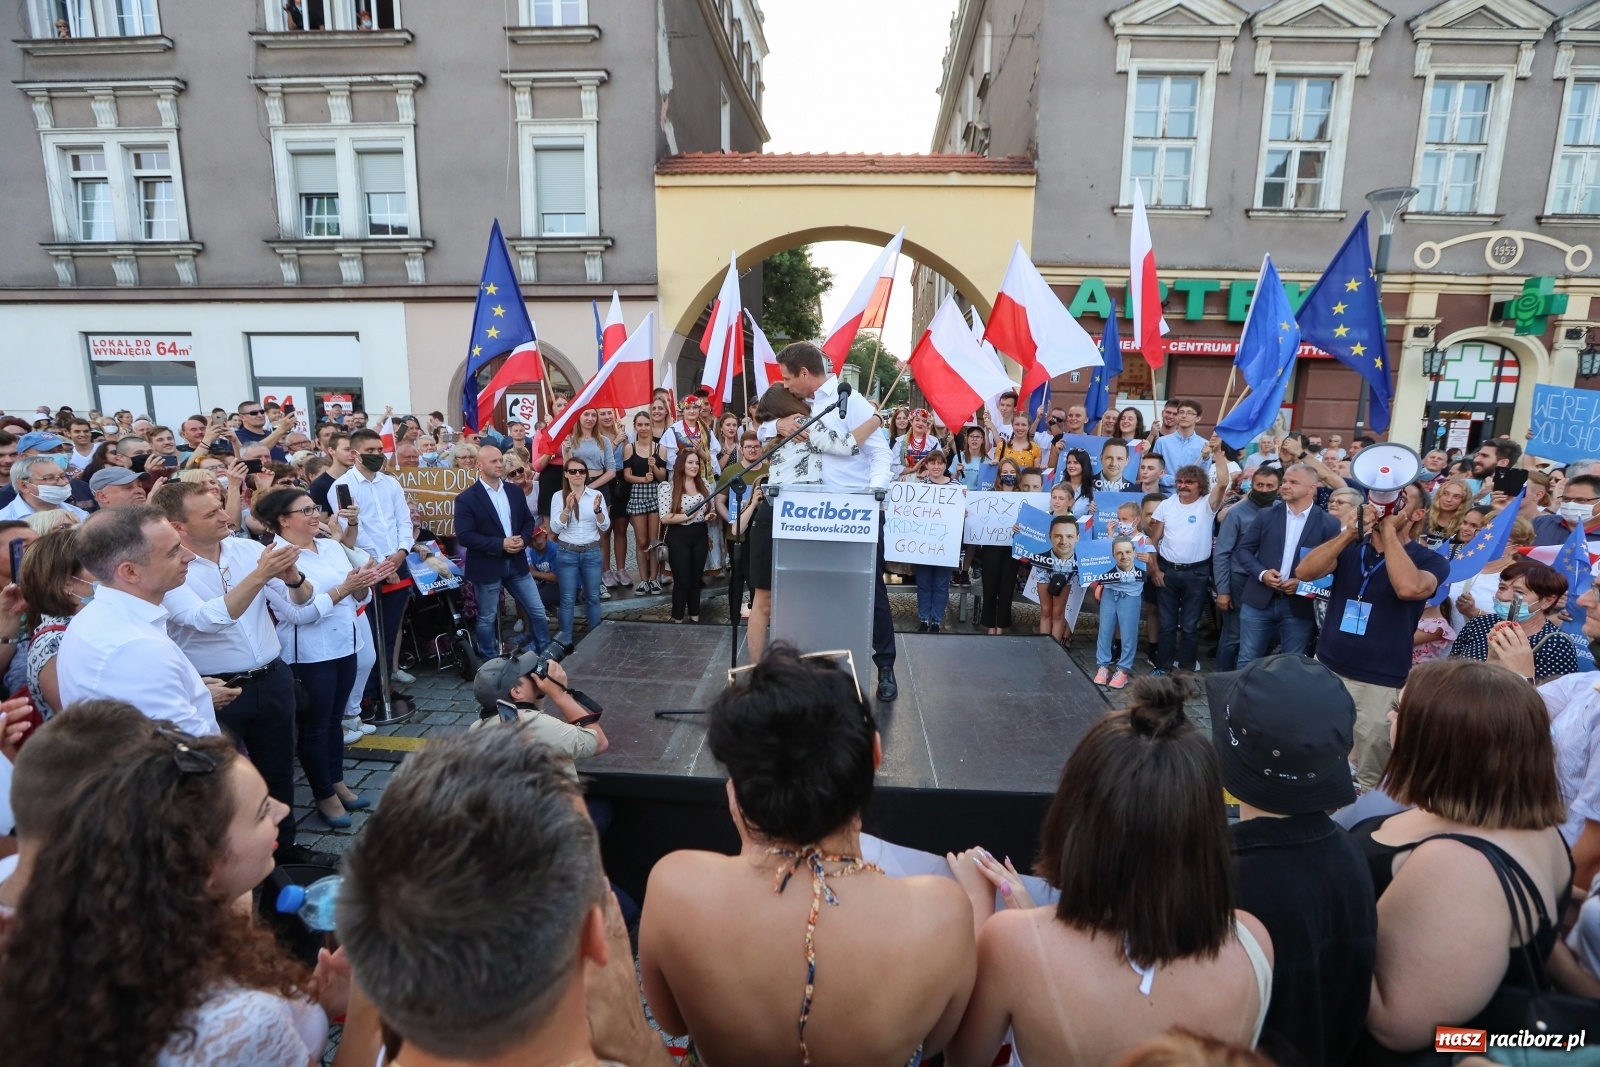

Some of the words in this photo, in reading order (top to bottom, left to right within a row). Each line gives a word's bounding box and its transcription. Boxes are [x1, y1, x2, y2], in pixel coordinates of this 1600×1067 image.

[1494, 246, 1517, 256] 1953
[92, 339, 132, 347] LOKAL
[136, 339, 151, 347] DO
[1169, 342, 1232, 352] CENTRUM
[93, 348, 152, 357] WYNAJĘCIA
[520, 397, 536, 421] 432
[1534, 390, 1589, 423] WE'RE
[1533, 419, 1564, 446] YOU
[780, 500, 873, 521] Racibórz
[780, 522, 871, 535] Trzaskowski2020
[895, 538, 946, 555] GOCHA
[1083, 570, 1142, 582] TRZASKOWSKI
